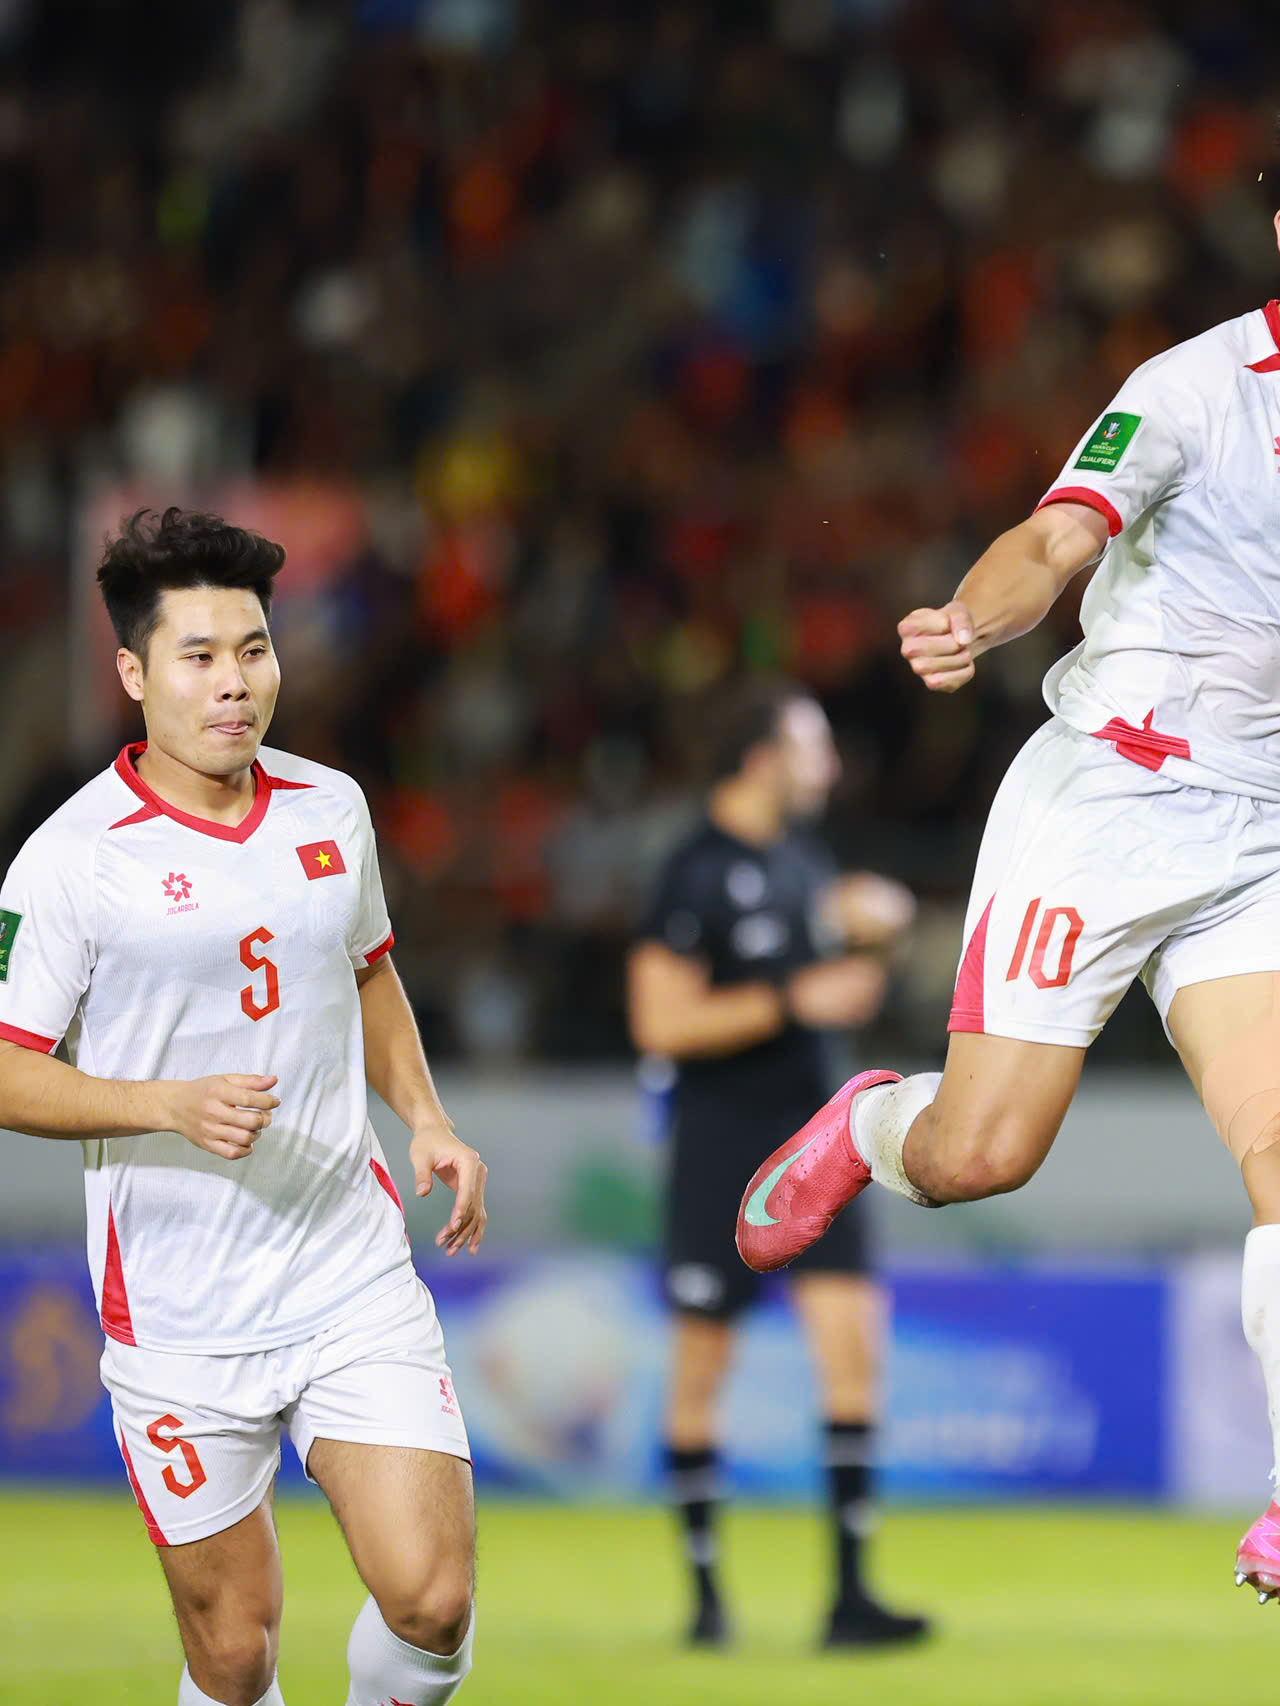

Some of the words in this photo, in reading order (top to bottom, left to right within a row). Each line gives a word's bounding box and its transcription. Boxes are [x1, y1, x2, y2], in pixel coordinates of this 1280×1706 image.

[1080, 455, 1117, 466] QUALIFIERS
[239, 925, 281, 1022] 5
[1005, 896, 1085, 990] 10
[146, 1413, 208, 1499] 5
